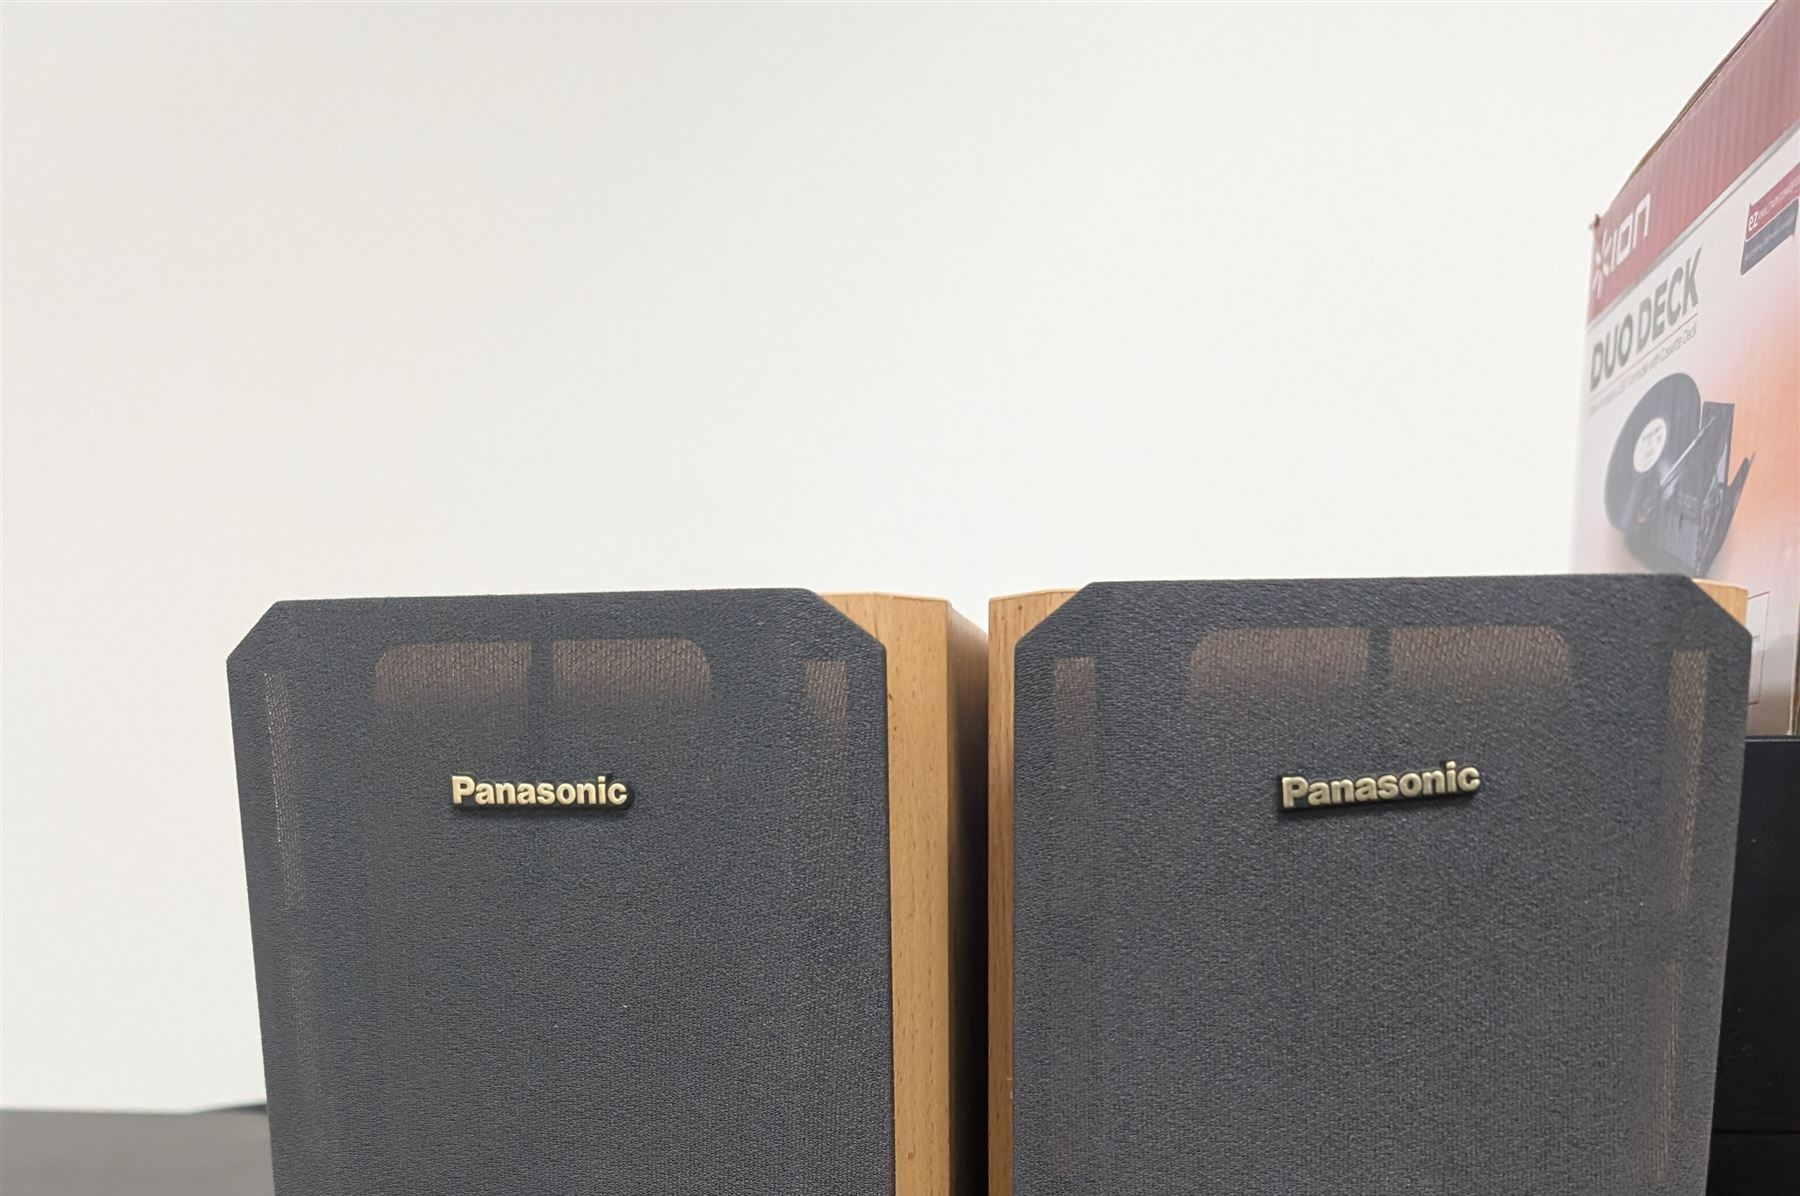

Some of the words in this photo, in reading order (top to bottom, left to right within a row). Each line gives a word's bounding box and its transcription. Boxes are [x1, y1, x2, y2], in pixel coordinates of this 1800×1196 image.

[1590, 313, 1633, 391] DUO
[1637, 247, 1702, 354] DECK
[452, 775, 628, 806] Panasonic
[1282, 761, 1481, 809] Panasonic
